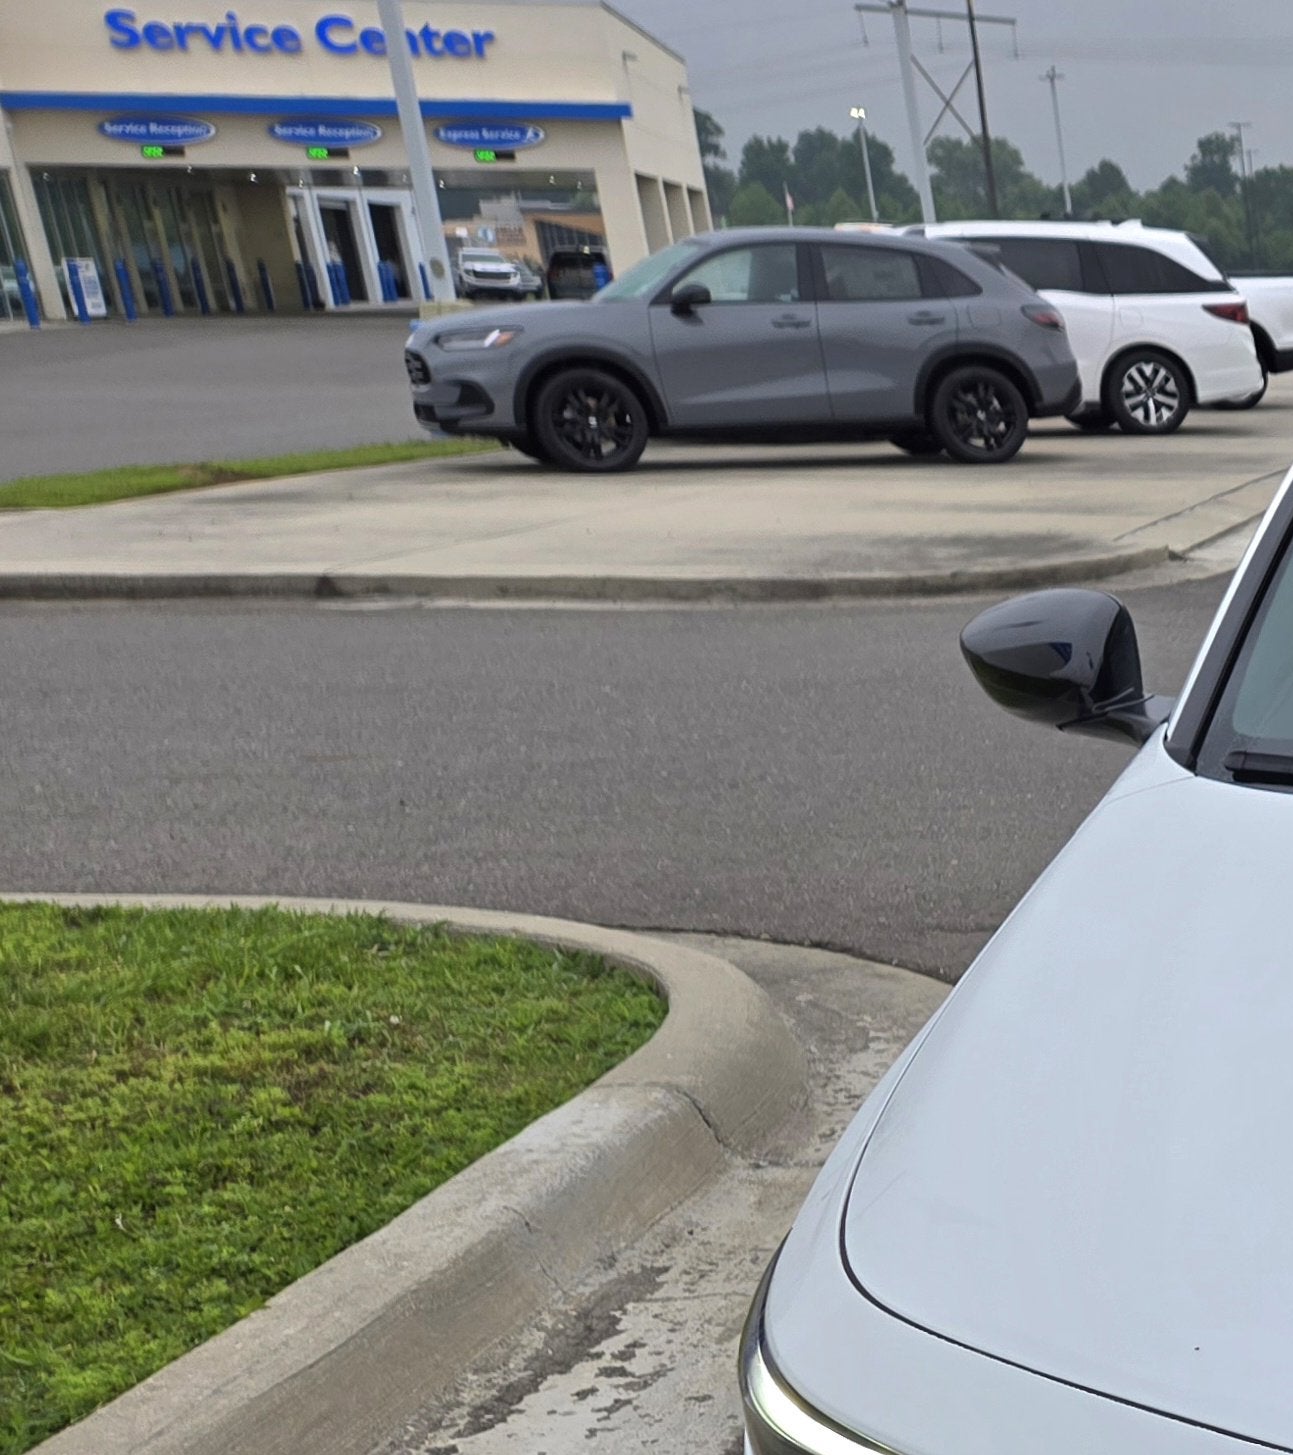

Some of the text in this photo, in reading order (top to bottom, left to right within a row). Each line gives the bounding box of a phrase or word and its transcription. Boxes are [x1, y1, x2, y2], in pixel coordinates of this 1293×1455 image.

[103, 8, 302, 53] Service
[103, 122, 147, 135] Service
[274, 124, 316, 137] Service
